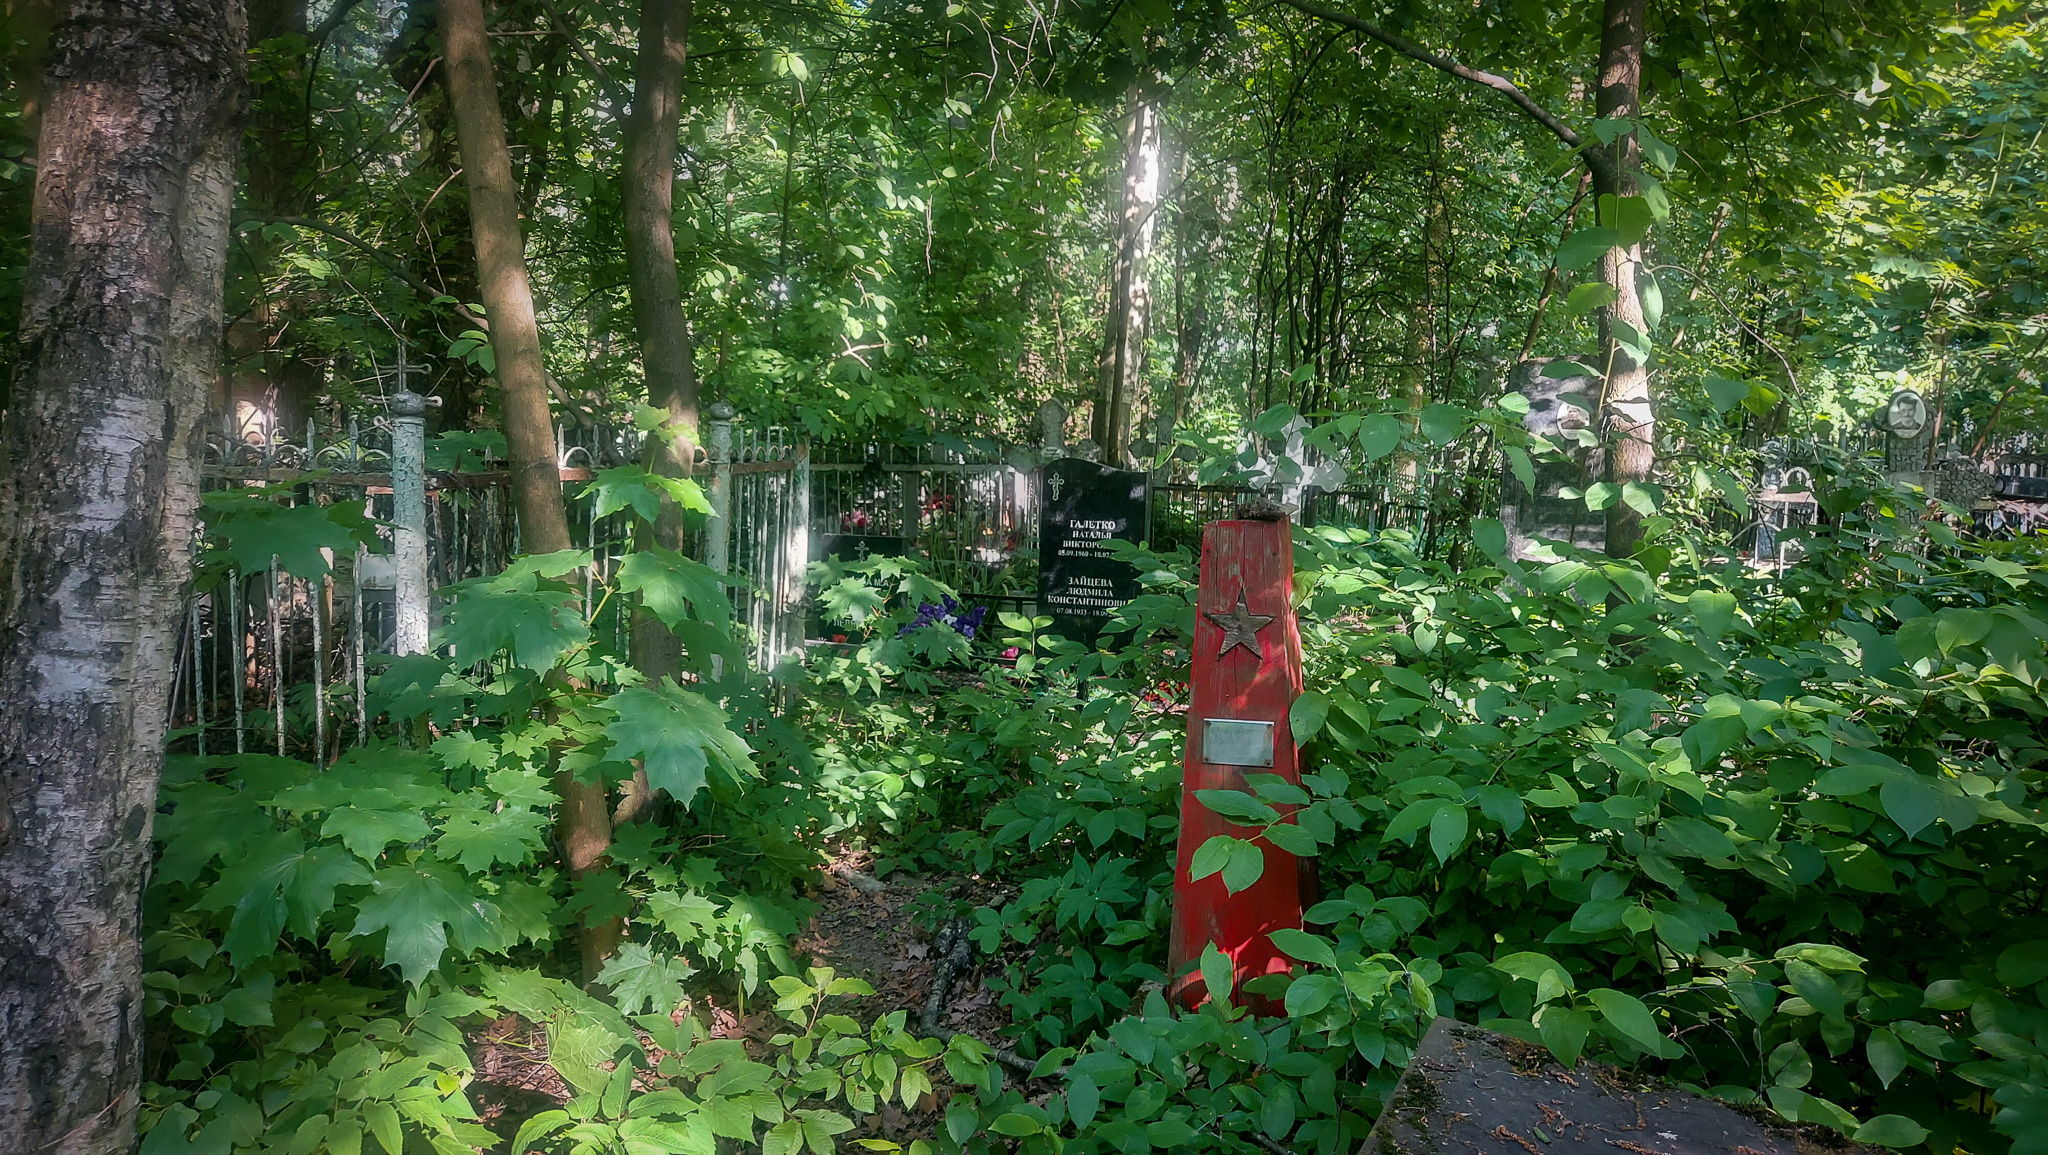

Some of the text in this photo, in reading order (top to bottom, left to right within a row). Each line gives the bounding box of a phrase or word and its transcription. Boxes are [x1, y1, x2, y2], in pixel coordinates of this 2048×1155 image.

[1070, 520, 1116, 530] ГАЛЕТКО
[1072, 530, 1112, 539] НАТАЛЬЯ
[1063, 540, 1104, 549] ВИКТОРО
[1068, 576, 1113, 587] ЗАЙЦЕВА
[1066, 587, 1113, 597] ЛЮДМИЛА
[1048, 594, 1126, 607] КОНСТАНТИНОВН
